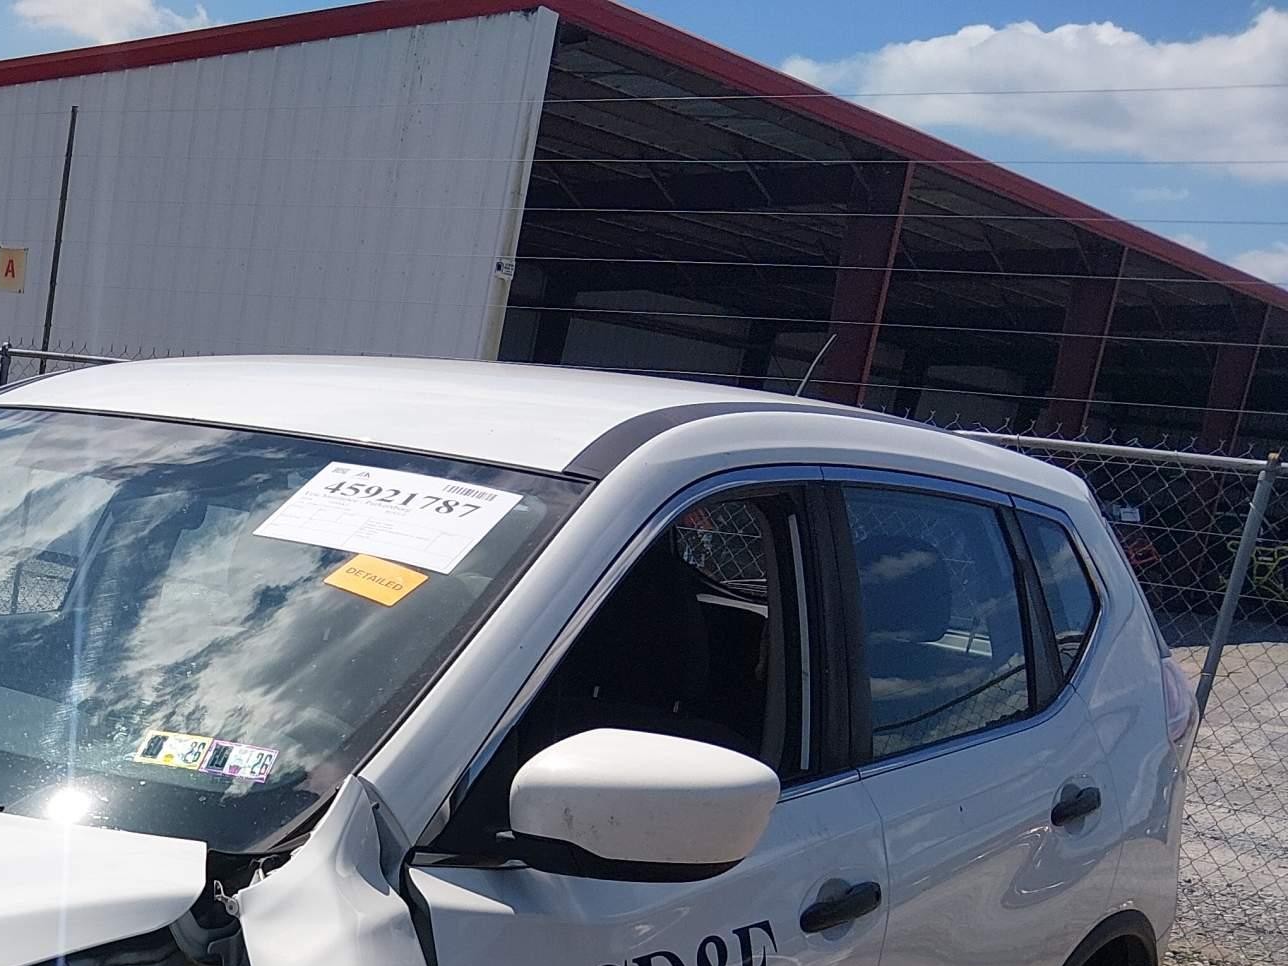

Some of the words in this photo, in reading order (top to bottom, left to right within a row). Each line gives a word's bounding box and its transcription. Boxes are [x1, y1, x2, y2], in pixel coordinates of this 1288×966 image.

[4, 258, 15, 278] A
[324, 481, 481, 518] 45921787
[345, 566, 403, 592] DETAILED
